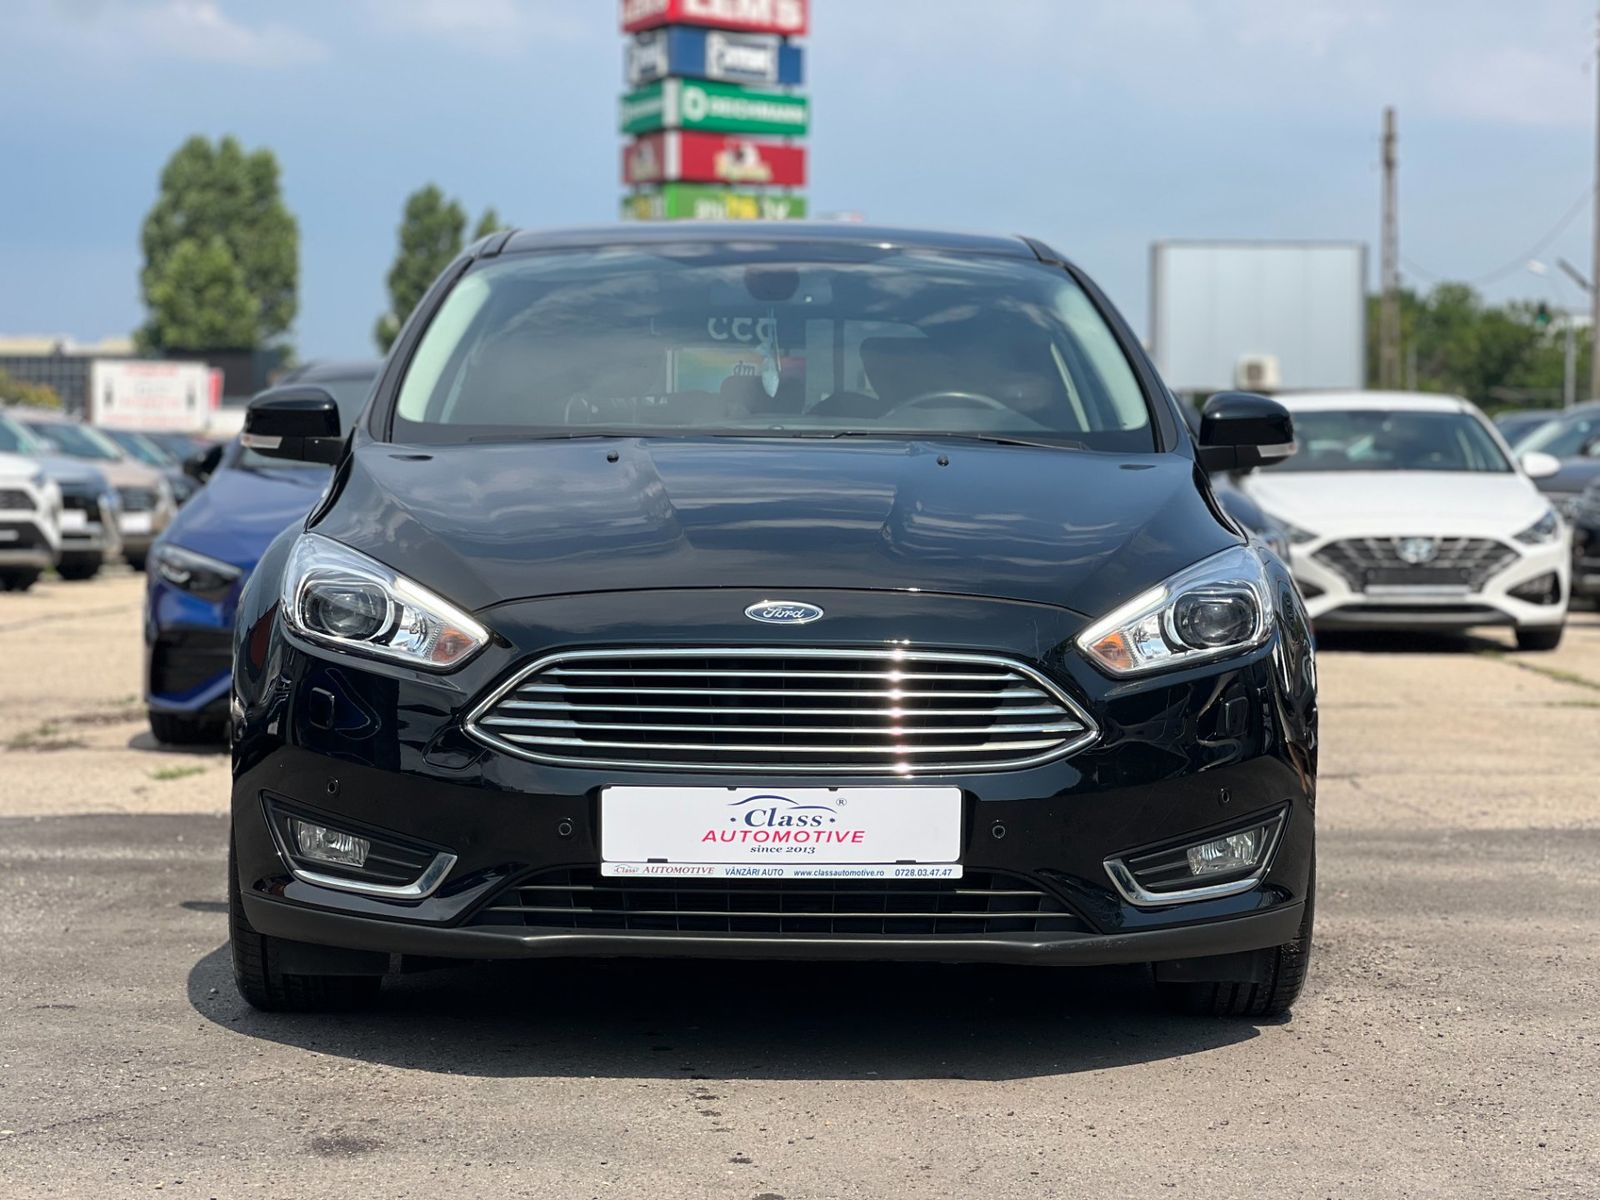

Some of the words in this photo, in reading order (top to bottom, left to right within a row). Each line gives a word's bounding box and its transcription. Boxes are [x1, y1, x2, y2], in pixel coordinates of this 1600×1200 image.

[744, 808, 823, 827] Class
[701, 830, 866, 843] AUTOMOTIVE
[750, 844, 783, 854] since
[786, 846, 816, 854] 2013
[643, 866, 715, 874] AUTOMOTIVE
[761, 868, 784, 876] AUTO
[793, 868, 885, 877] www.classautomotive.ro
[894, 868, 953, 877] 0728.03.47.47
